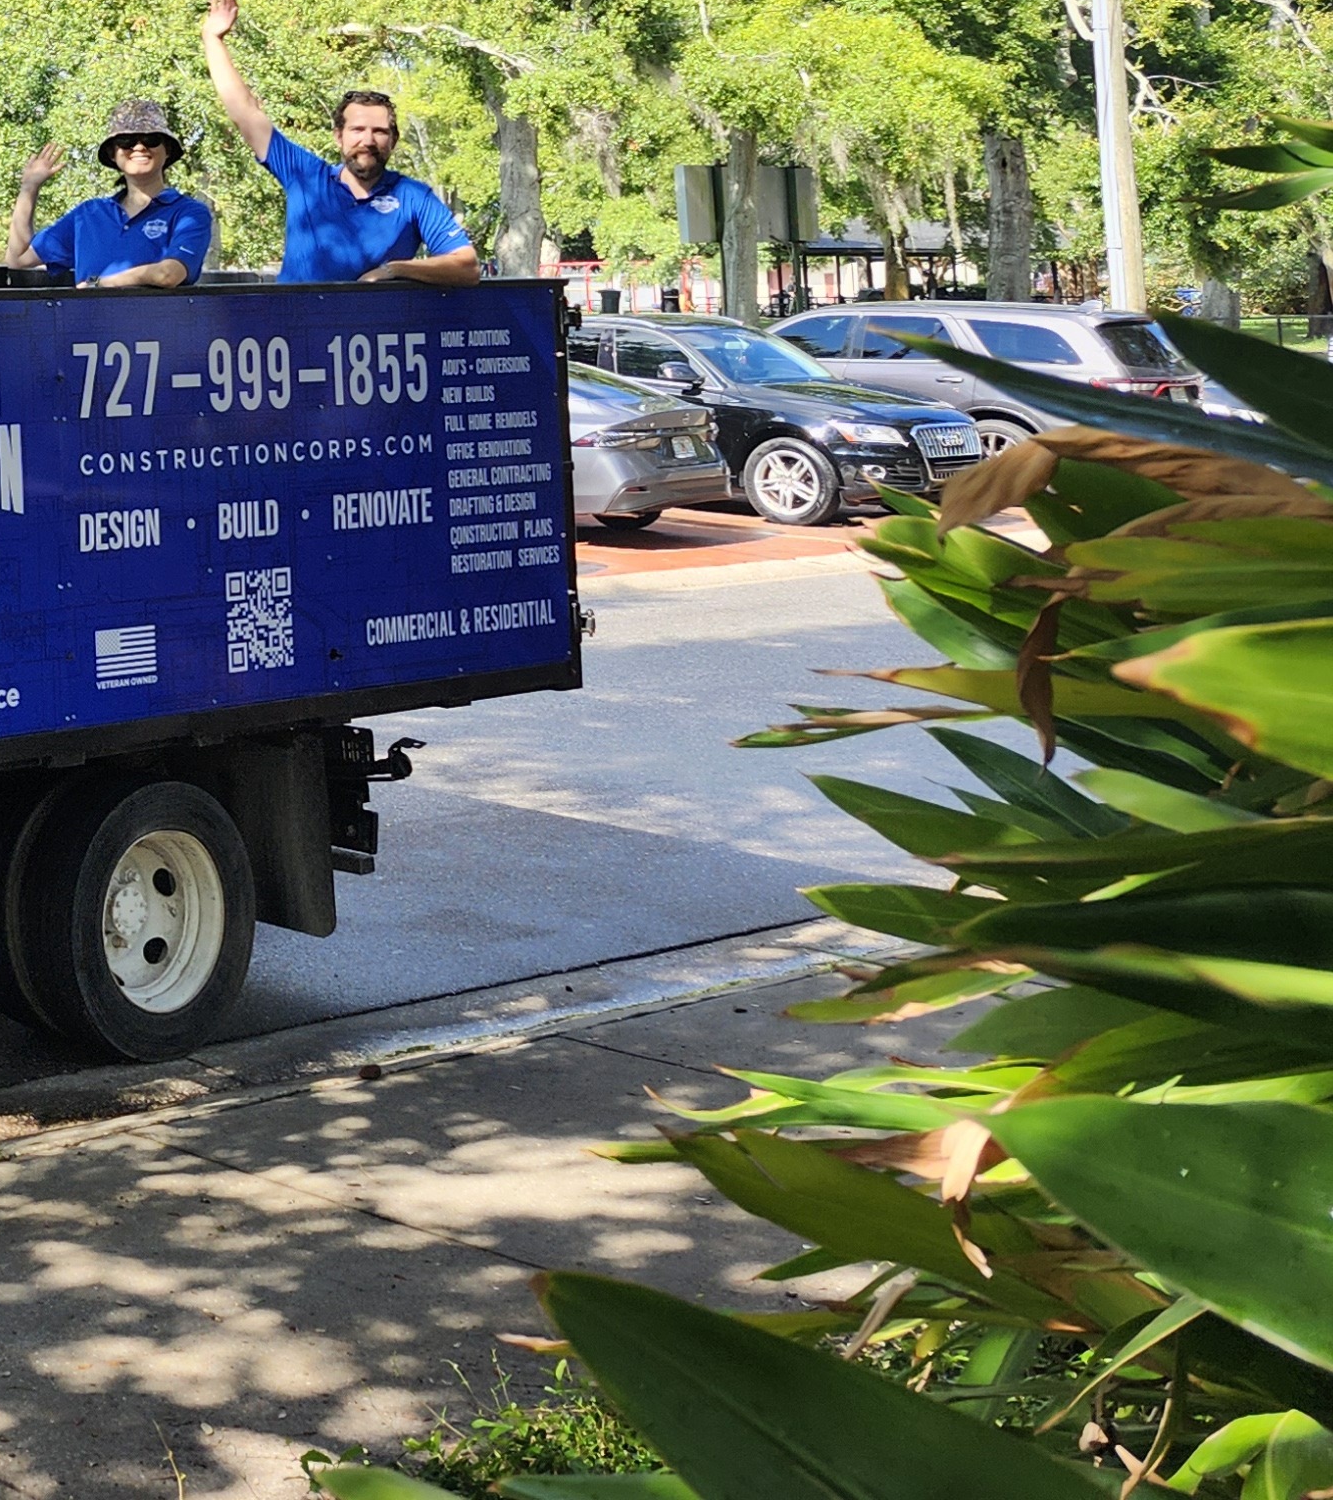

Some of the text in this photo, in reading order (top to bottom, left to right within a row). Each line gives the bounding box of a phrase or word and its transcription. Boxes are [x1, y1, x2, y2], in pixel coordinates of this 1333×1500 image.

[440, 329, 511, 348] HOME ADDITIONS
[73, 332, 428, 418] 727-999-1855
[442, 356, 530, 376] ADU'S CONVERSIONS
[442, 385, 495, 403] NEW BUILDS
[444, 411, 537, 432] FULL HOME REMODELS
[79, 433, 433, 476] CONSTRUCTIONCORPS.COM
[446, 438, 532, 460] OFFICE RENOVATIONS
[448, 463, 551, 488] GENERAL CONTRACTING
[449, 492, 536, 517] DRAFTING & DESIGN
[79, 487, 433, 553] DESIGN BUILD RENOVATE
[450, 518, 553, 546] CONSTRUCTION PLANS
[451, 545, 560, 574] RESTORATION SERVICES
[366, 599, 556, 647] COMMERCIAL & RESIDENTIAL
[96, 675, 158, 690] VETERAN OWNED
